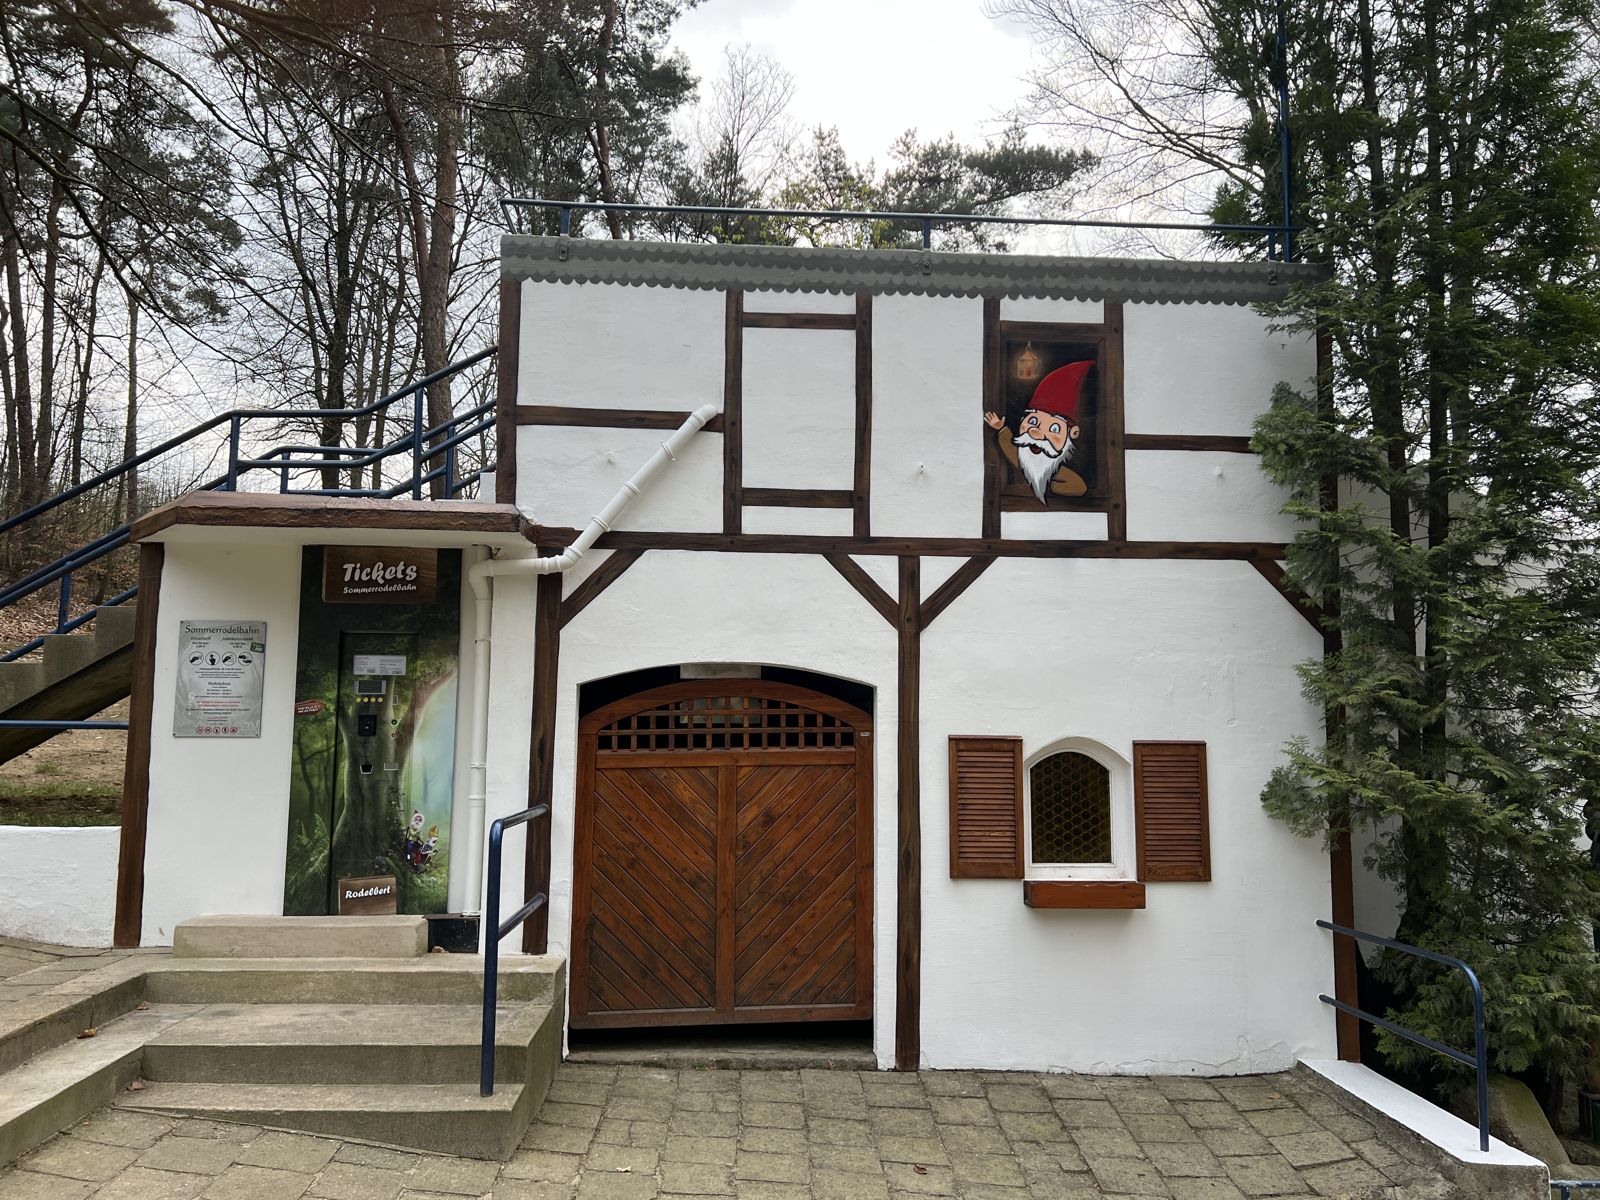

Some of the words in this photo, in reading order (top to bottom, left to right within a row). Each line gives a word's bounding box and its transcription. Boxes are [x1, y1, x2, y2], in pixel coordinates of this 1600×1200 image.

[343, 561, 417, 584] Tickets
[343, 583, 417, 594] Sommerrodelbahn
[184, 625, 259, 634] Sommerrodelbahn
[345, 885, 391, 899] Rodelbert
